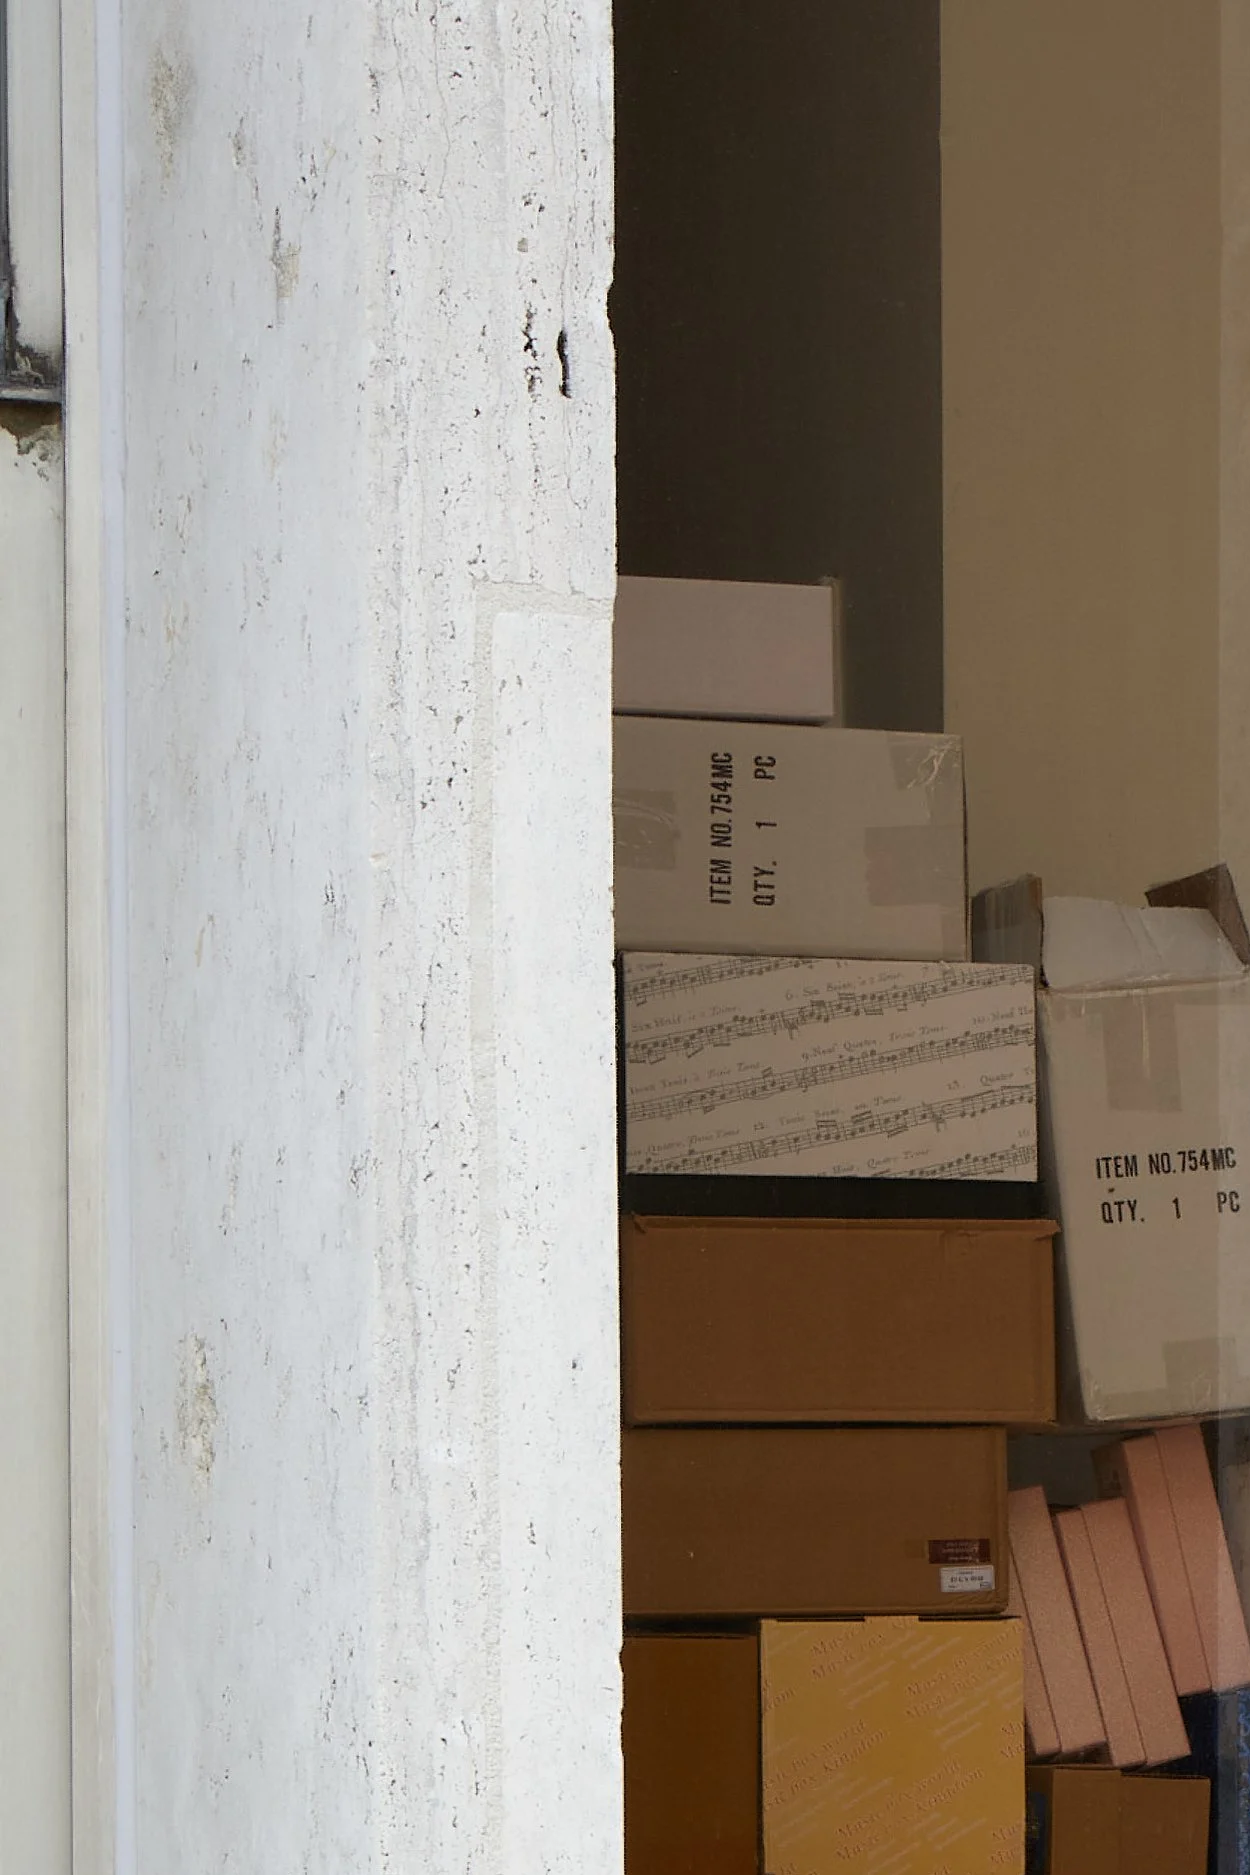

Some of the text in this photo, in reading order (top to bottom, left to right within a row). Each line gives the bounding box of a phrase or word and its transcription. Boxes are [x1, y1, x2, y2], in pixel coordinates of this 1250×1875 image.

[753, 755, 777, 906] QTY. 1 PC
[710, 859, 732, 904] ITEM
[1096, 1155, 1138, 1179] ITEM
[1101, 1190, 1240, 1224] QTY. 1 PC
